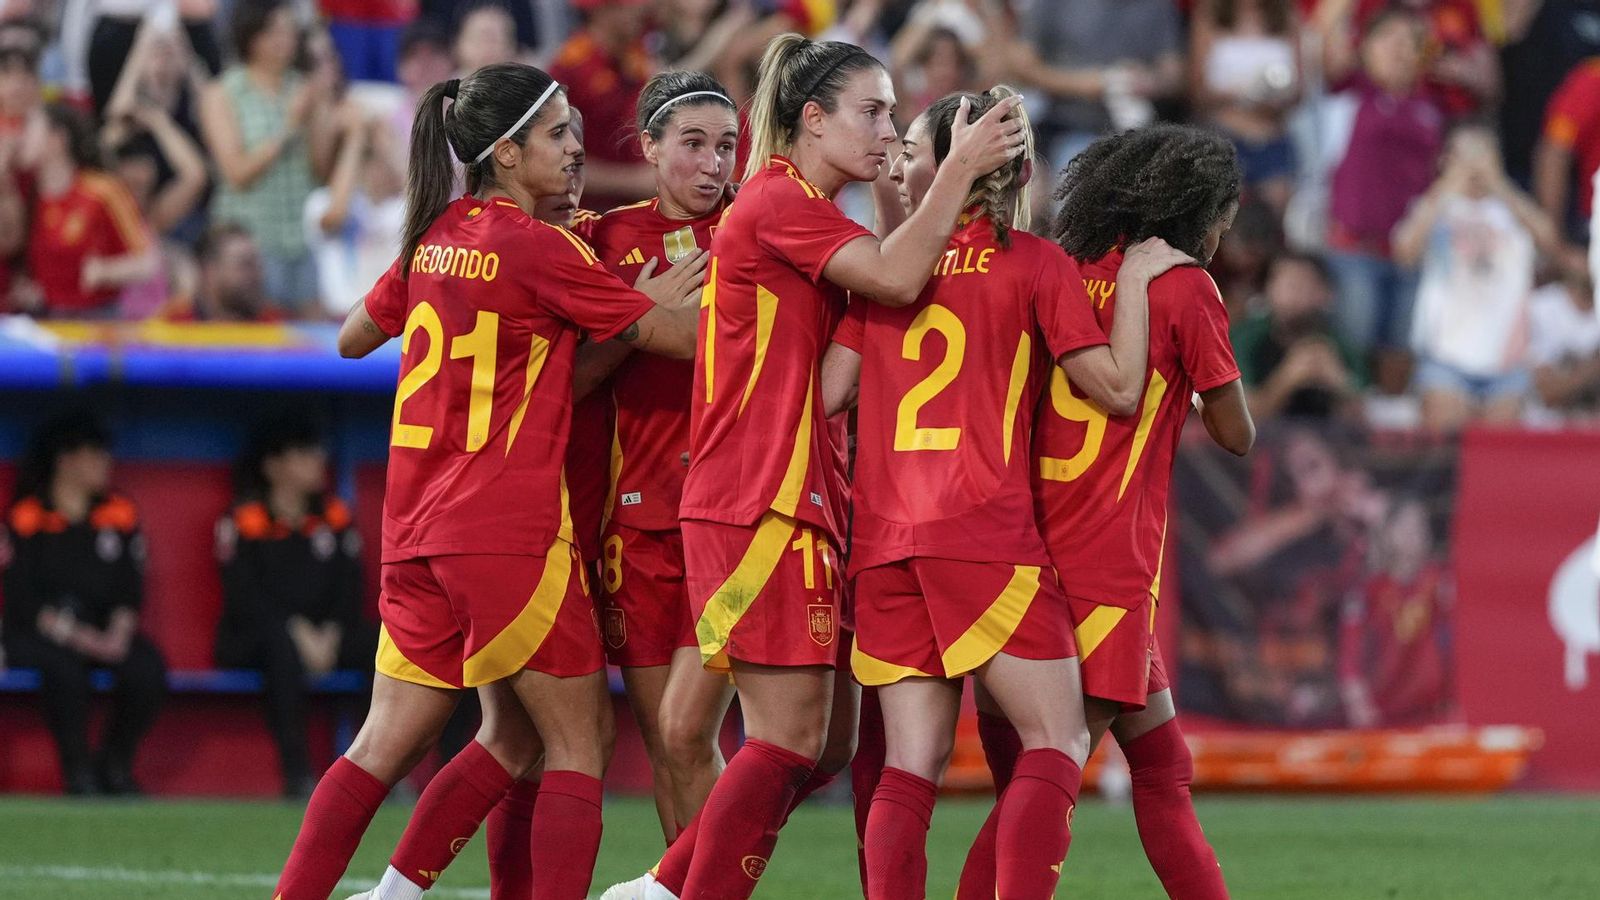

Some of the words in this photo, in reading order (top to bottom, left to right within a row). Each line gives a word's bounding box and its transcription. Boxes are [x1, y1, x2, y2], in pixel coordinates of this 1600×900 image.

[412, 244, 499, 281] REDONDO
[1083, 279, 1116, 309] KY
[391, 301, 499, 452] 21
[894, 303, 966, 451] 2
[1040, 364, 1109, 482] 9
[604, 534, 624, 594] 8
[792, 528, 832, 589] 11
